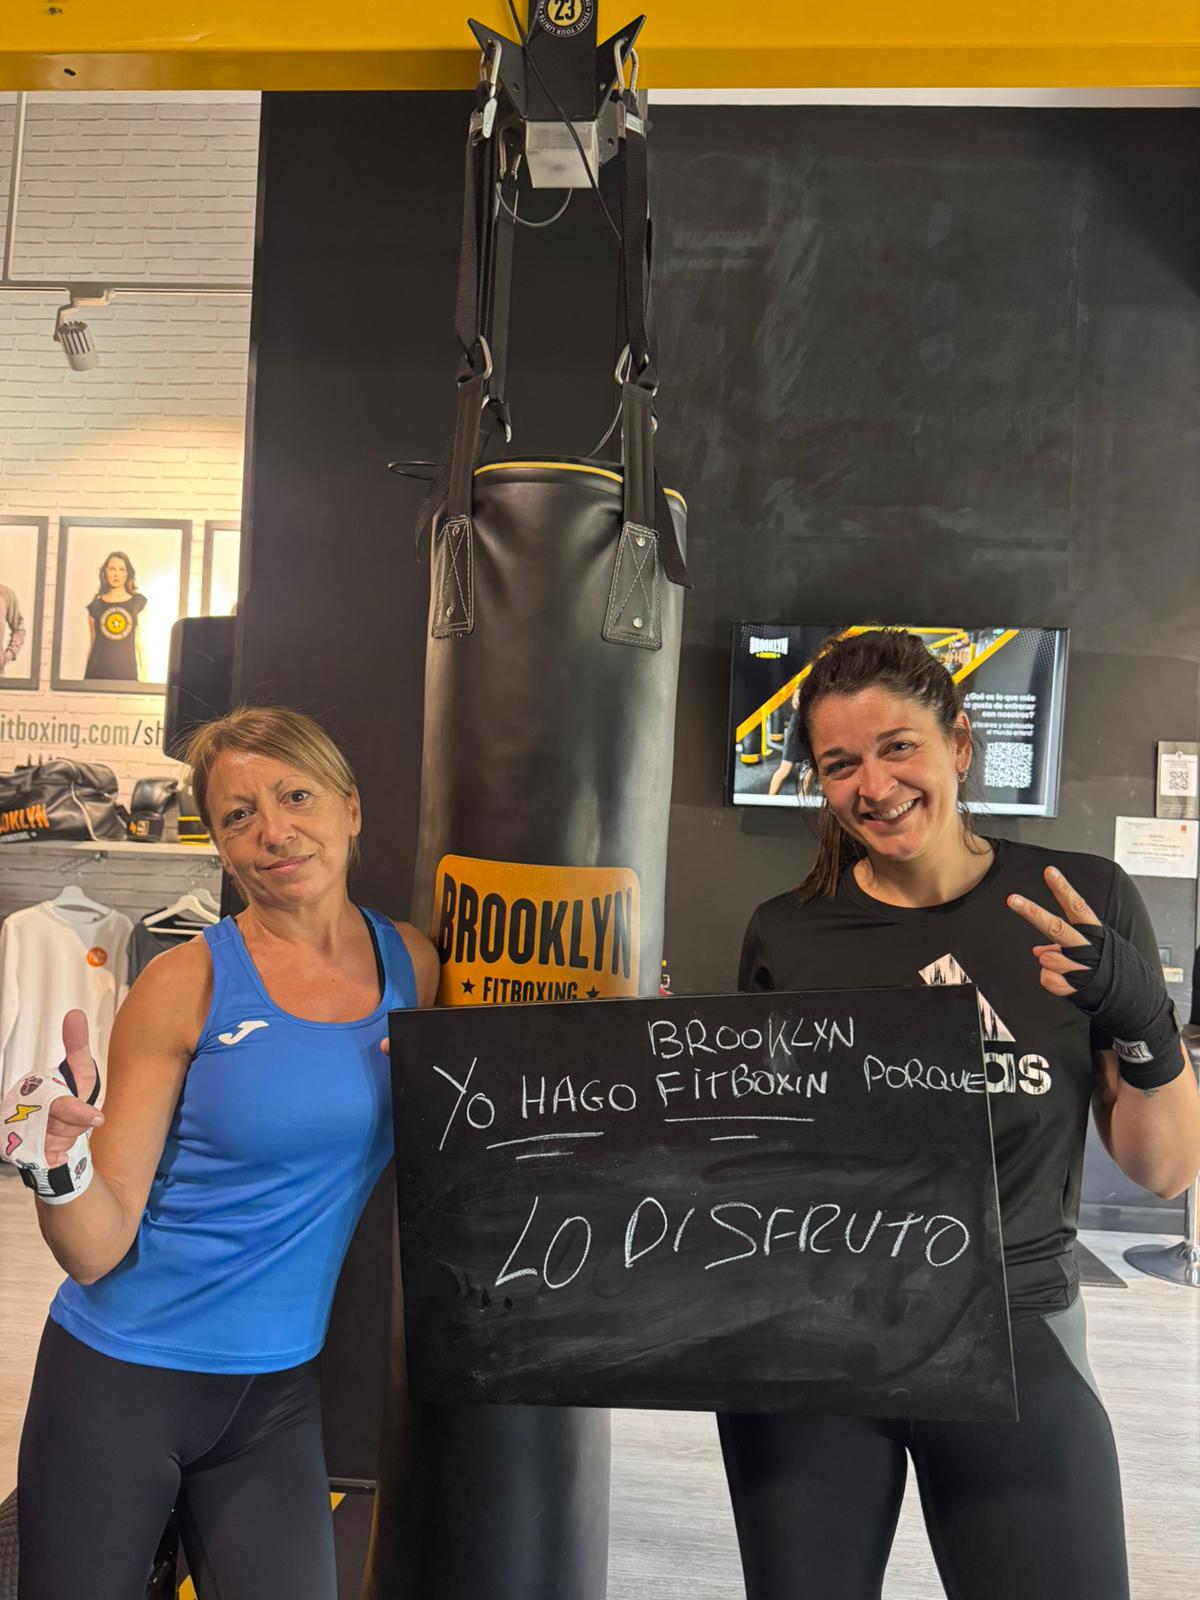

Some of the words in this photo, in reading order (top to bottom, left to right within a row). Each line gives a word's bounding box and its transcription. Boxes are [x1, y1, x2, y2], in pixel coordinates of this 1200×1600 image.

[554, 0, 576, 21] 23
[575, 12, 592, 31] FIGHT
[539, 14, 557, 33] LIMITS
[556, 28, 576, 36] YOUR
[438, 872, 632, 980] BROOKLYN
[482, 976, 578, 1003] FITBOXING
[521, 1075, 637, 1119] HAGO
[863, 1054, 985, 1094] PORQUE
[495, 1196, 592, 1289] LO
